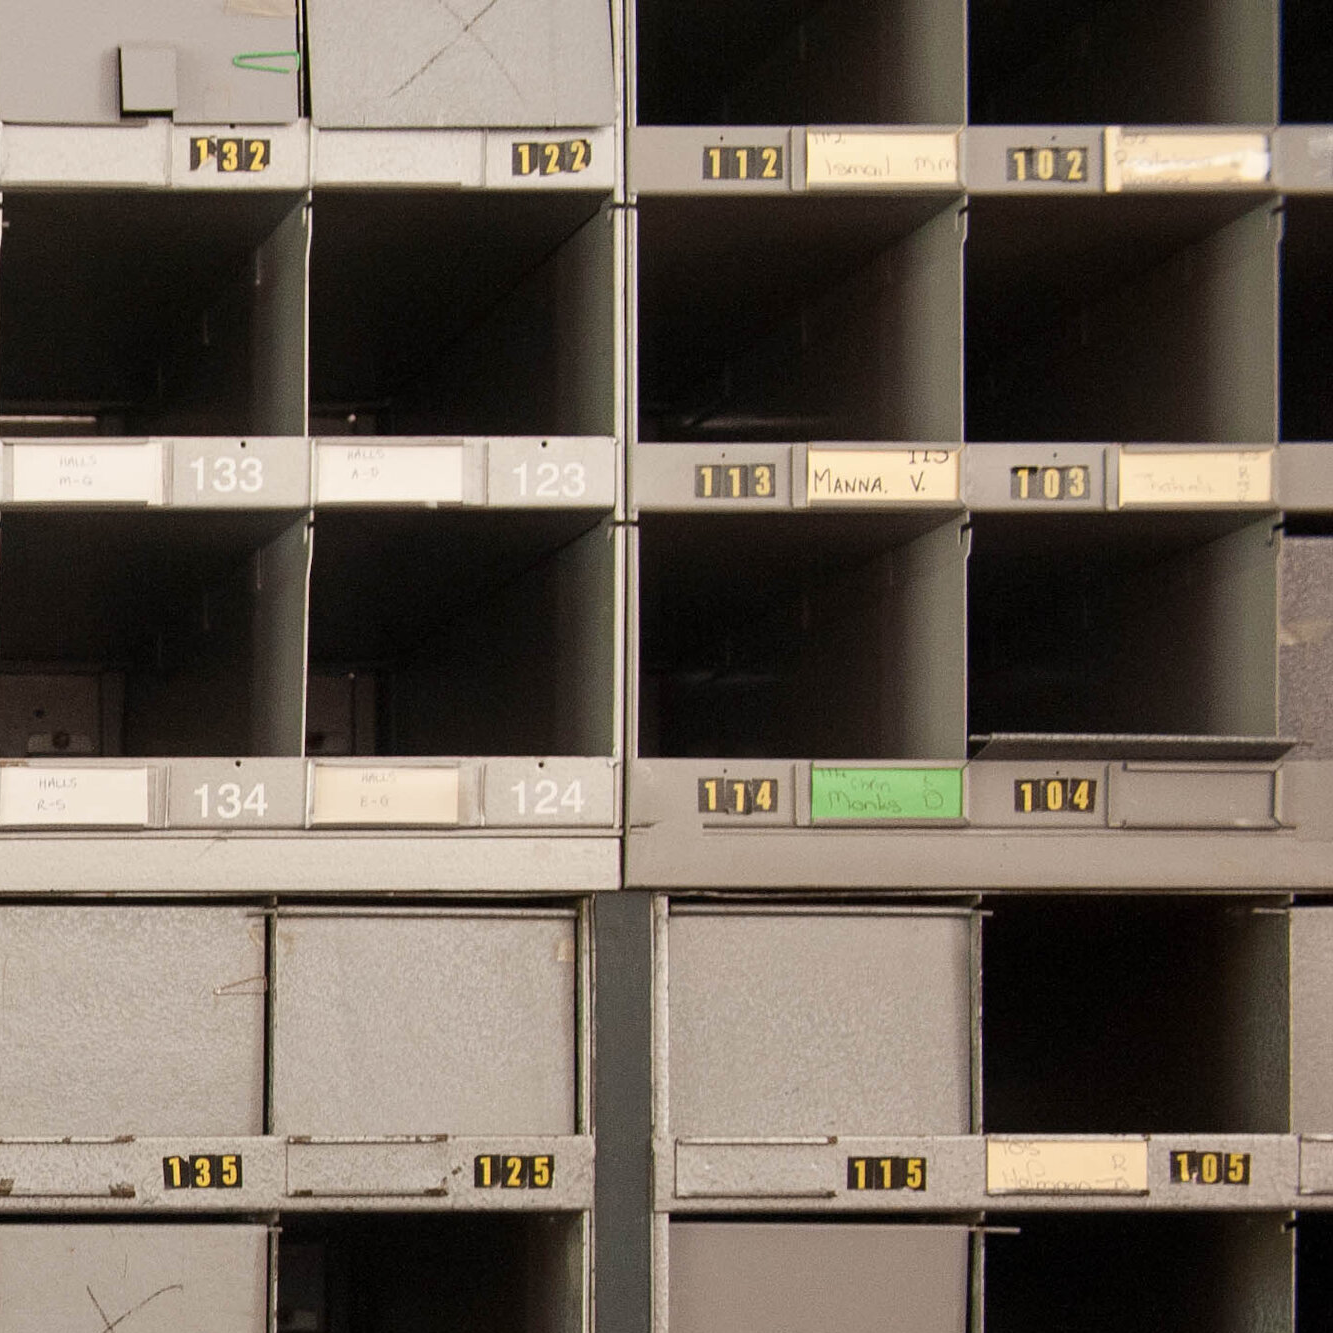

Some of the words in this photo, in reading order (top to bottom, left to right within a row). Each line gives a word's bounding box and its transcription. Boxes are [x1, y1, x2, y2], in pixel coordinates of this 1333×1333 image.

[196, 138, 265, 171] 132
[518, 139, 585, 174] 122
[709, 147, 777, 179] 112
[1014, 149, 1081, 180] 102
[59, 456, 97, 468] HALLS
[347, 447, 385, 459] HALLS
[189, 456, 264, 492] 133
[511, 461, 587, 497] 123
[702, 467, 770, 497] 113
[1017, 467, 1083, 498] 103
[39, 777, 77, 789] HALLS
[510, 778, 586, 815] 124
[705, 780, 771, 812] 114
[1021, 779, 1089, 813] 104
[192, 783, 269, 820] 134
[169, 1155, 237, 1187] 135
[480, 1156, 549, 1186] 125
[855, 1157, 921, 1190] 115
[1179, 1152, 1249, 1184] 105
